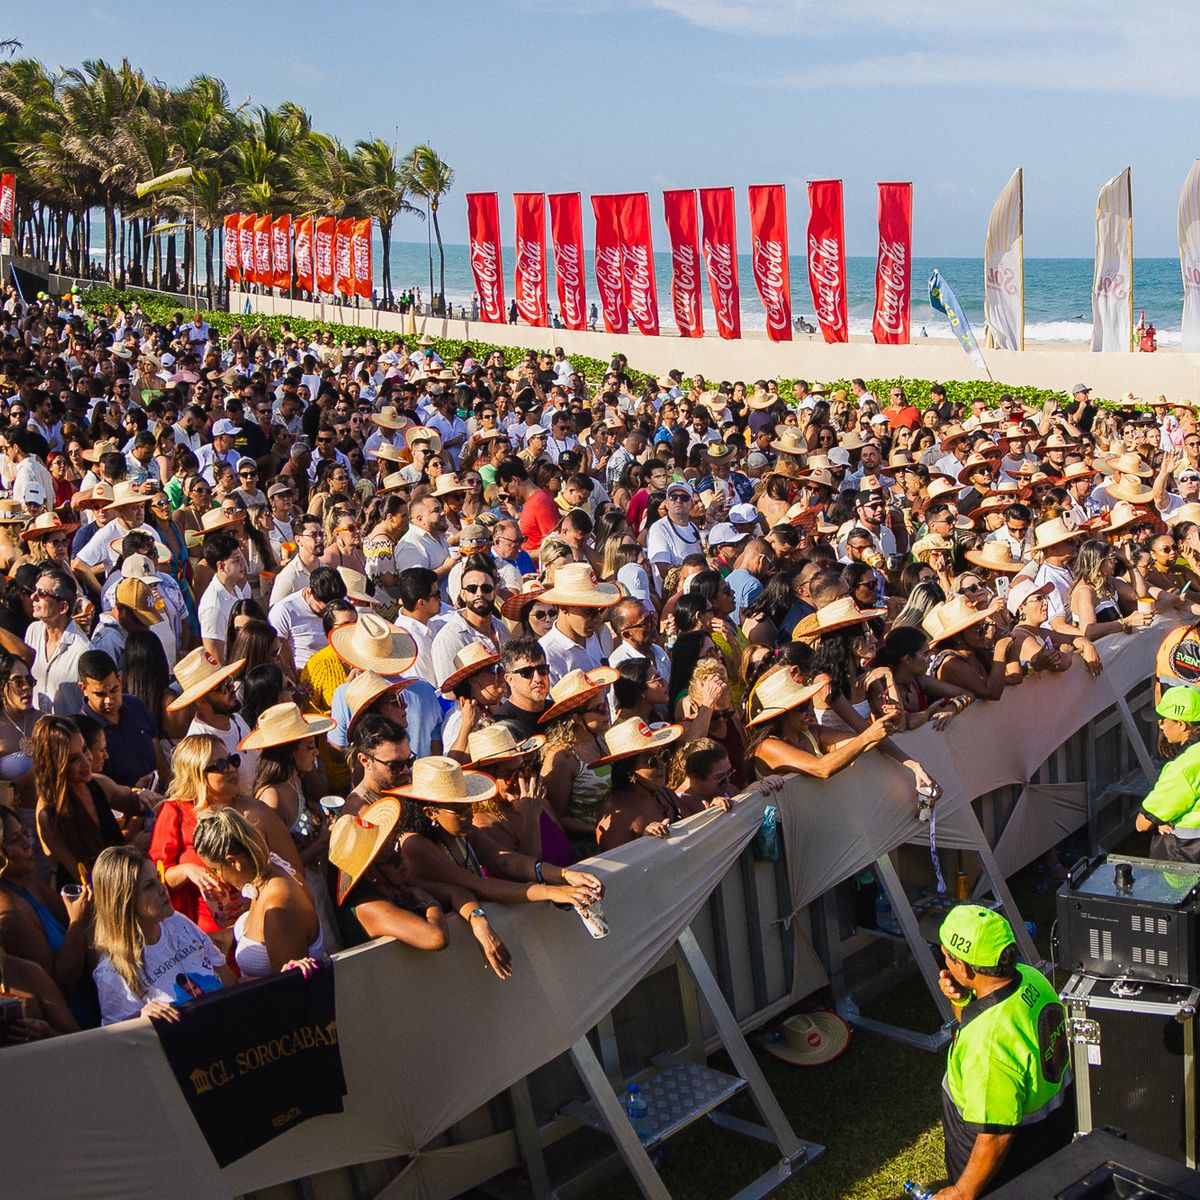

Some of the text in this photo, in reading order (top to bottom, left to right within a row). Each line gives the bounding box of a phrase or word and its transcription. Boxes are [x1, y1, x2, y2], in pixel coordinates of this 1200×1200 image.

[323, 234, 332, 275] GANHA
[1174, 705, 1186, 716] 117
[950, 933, 972, 954] 023
[1020, 983, 1041, 1009] 023
[235, 1024, 330, 1076] SOROCABA
